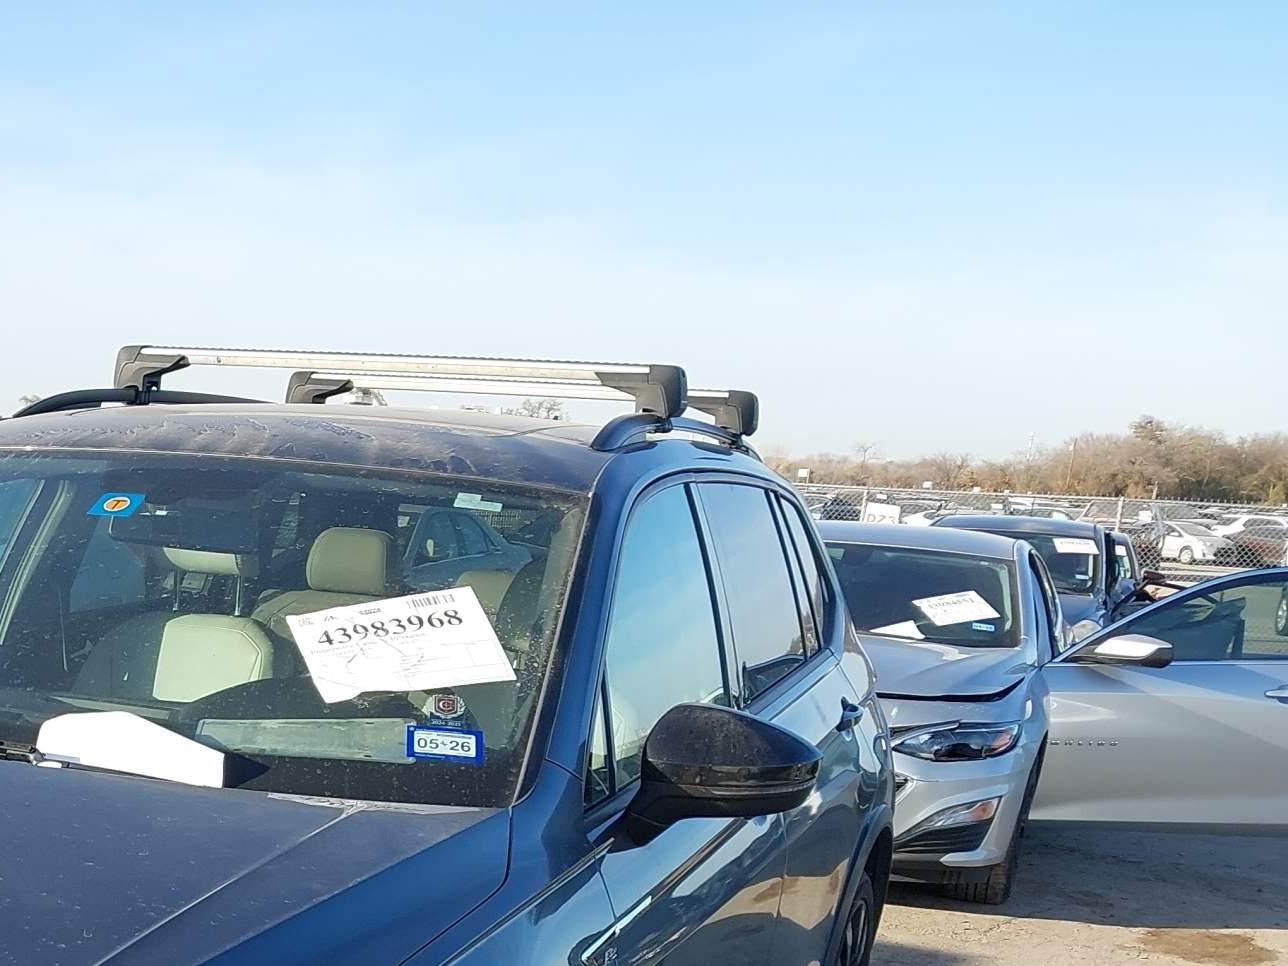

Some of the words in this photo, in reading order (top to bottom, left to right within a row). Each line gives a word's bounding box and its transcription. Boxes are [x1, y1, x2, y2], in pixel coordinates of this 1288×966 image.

[317, 609, 463, 646] 43983968
[417, 737, 439, 750] 05
[449, 740, 471, 753] 26
